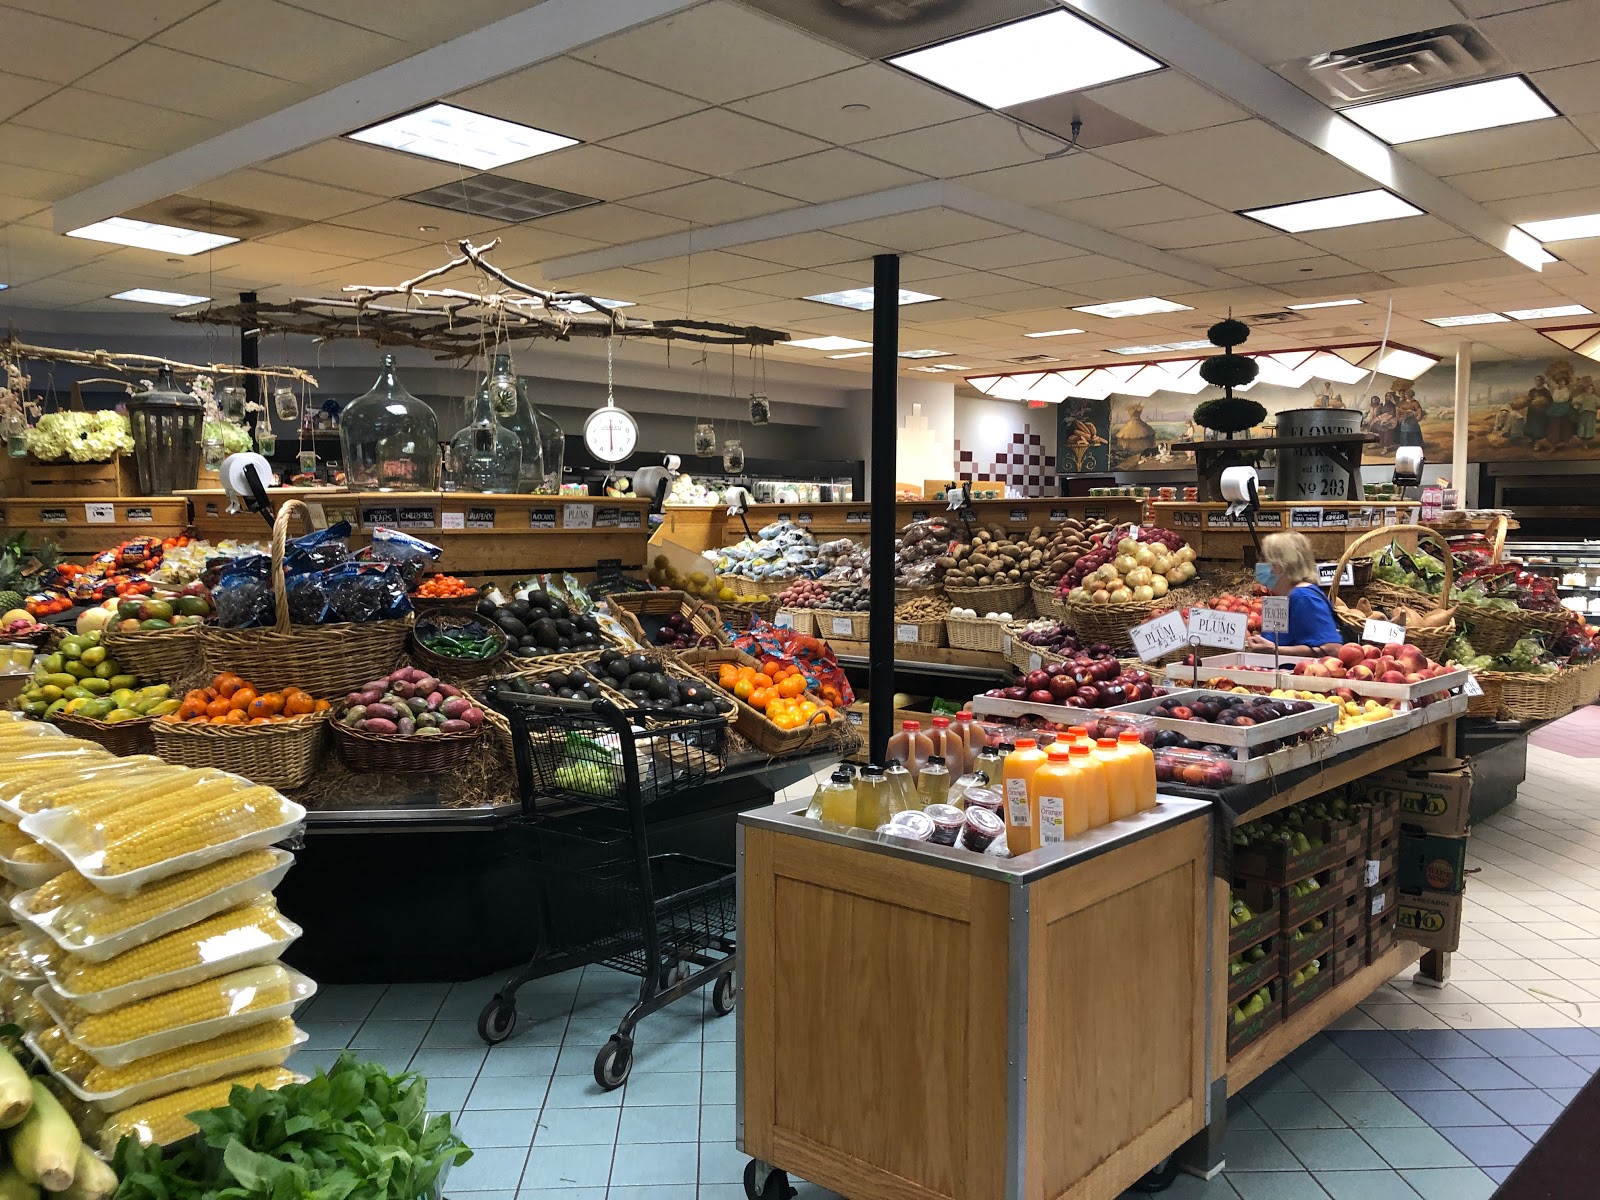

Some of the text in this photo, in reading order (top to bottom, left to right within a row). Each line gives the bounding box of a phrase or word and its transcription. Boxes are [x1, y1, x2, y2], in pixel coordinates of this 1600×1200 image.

[1320, 478, 1345, 496] 203
[370, 514, 393, 522] PEARS
[400, 511, 434, 520] CHERRIES
[1264, 606, 1288, 620] PEACHES
[1199, 618, 1237, 636] PLUMS
[1144, 623, 1175, 646] PLUM
[1416, 780, 1453, 790] AVOCADOS
[1007, 789, 1026, 797] Orange
[1041, 807, 1063, 818] Orange
[1041, 814, 1055, 822] Juice
[1412, 897, 1450, 907] AVOCADOS
